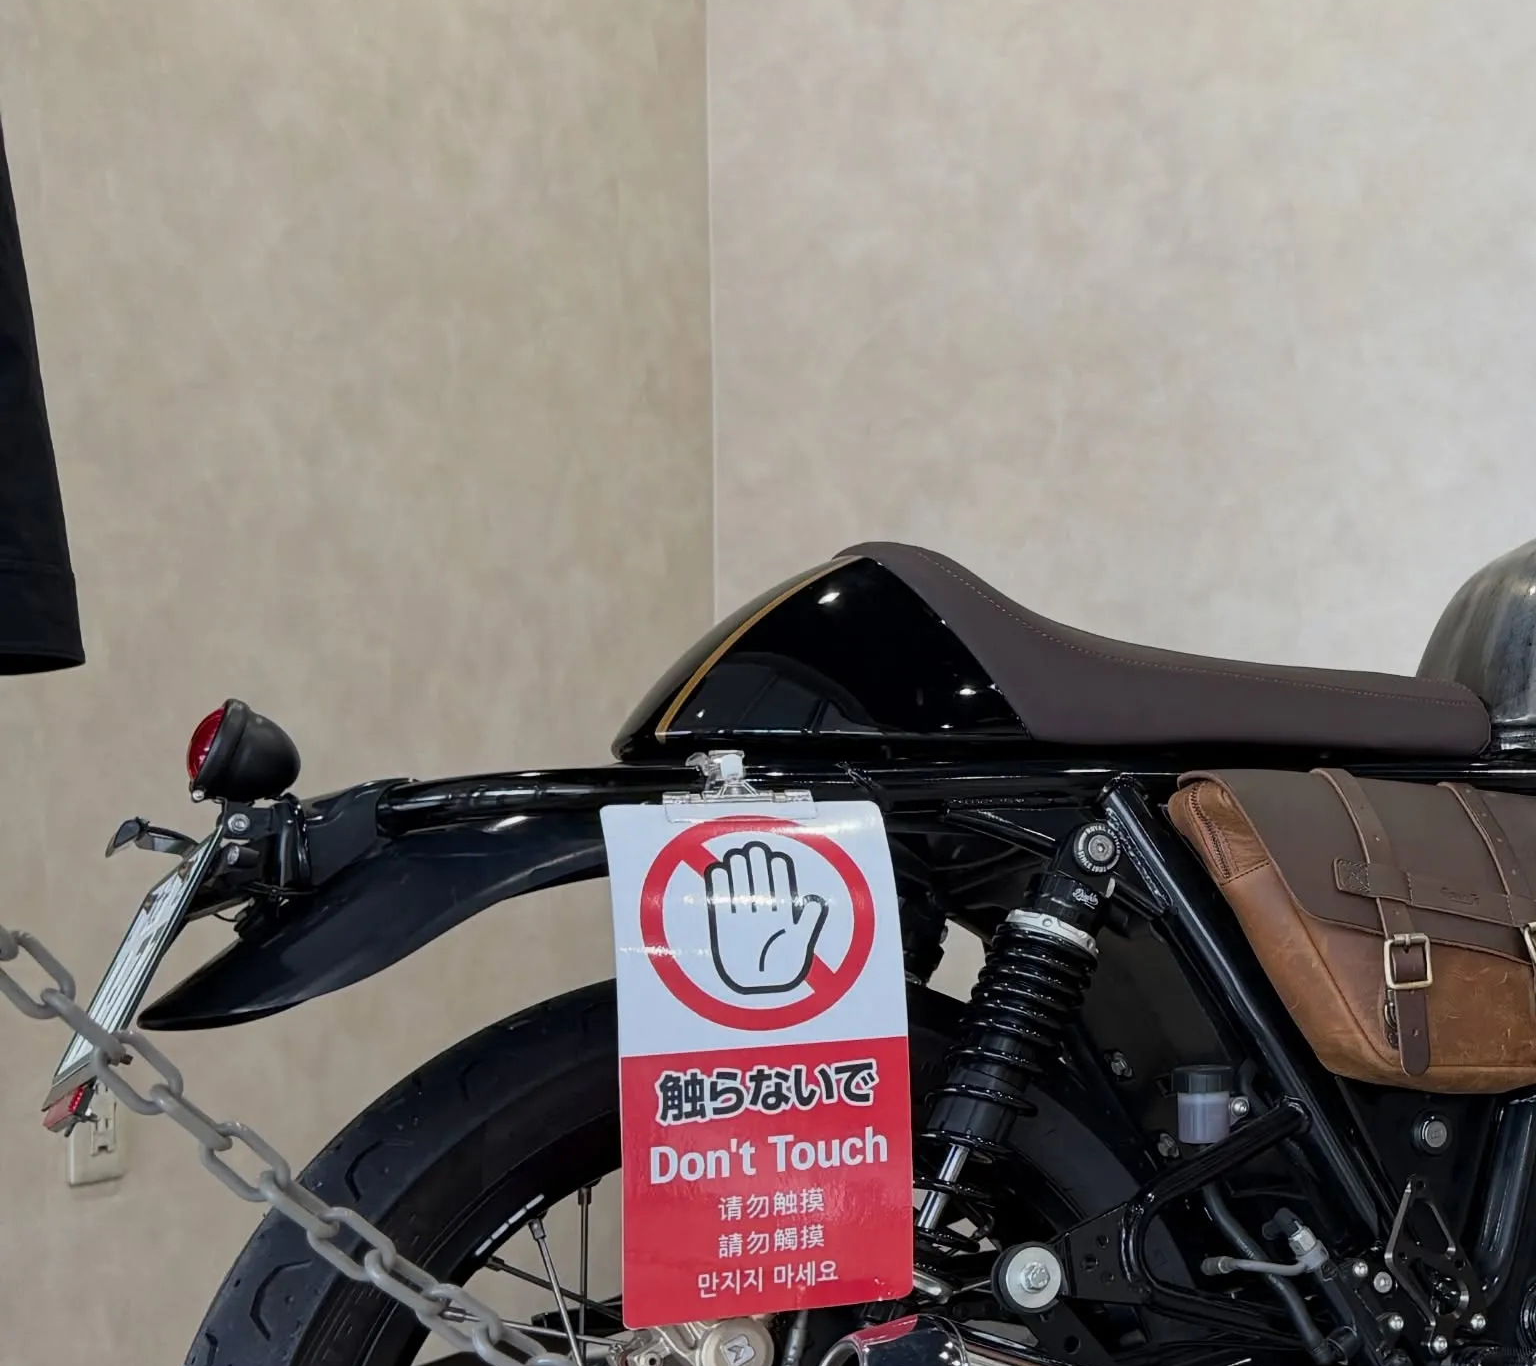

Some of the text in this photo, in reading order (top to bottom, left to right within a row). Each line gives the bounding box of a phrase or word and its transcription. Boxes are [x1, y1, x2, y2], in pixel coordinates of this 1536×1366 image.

[655, 1059, 878, 1125] 触らないで
[650, 1128, 888, 1185] Don't Touch
[717, 1187, 825, 1222] 请勿触摸
[717, 1225, 825, 1259] 請勿觸摸
[697, 1263, 839, 1298] 만지지 마세요
